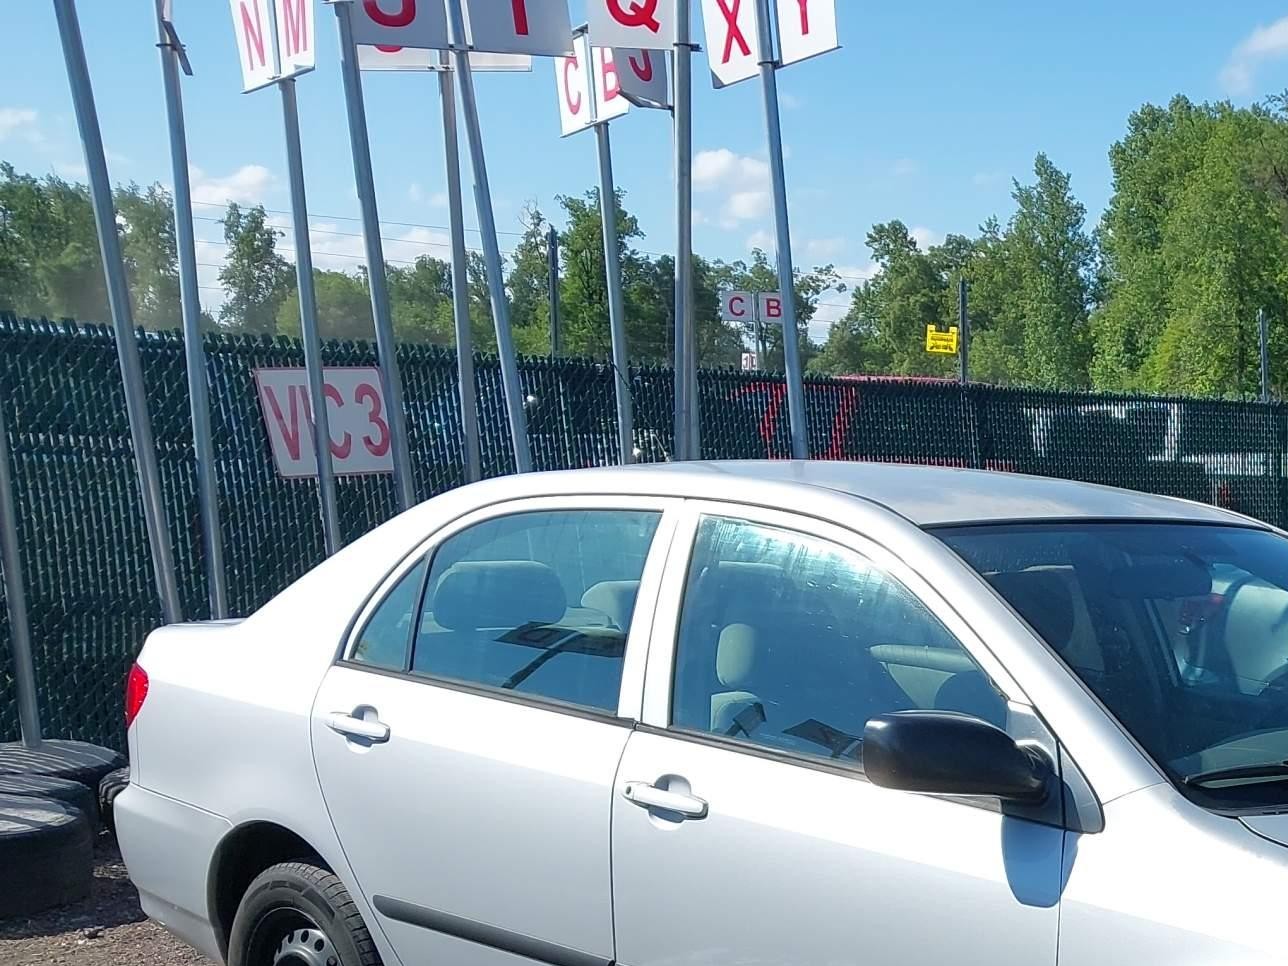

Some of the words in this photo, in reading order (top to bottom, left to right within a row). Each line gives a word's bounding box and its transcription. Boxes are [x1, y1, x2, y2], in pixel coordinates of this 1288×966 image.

[240, 0, 266, 71] N
[282, 0, 308, 57] M
[716, 0, 752, 64] X
[564, 57, 582, 115] C
[728, 296, 745, 317] C
[766, 298, 782, 317] B
